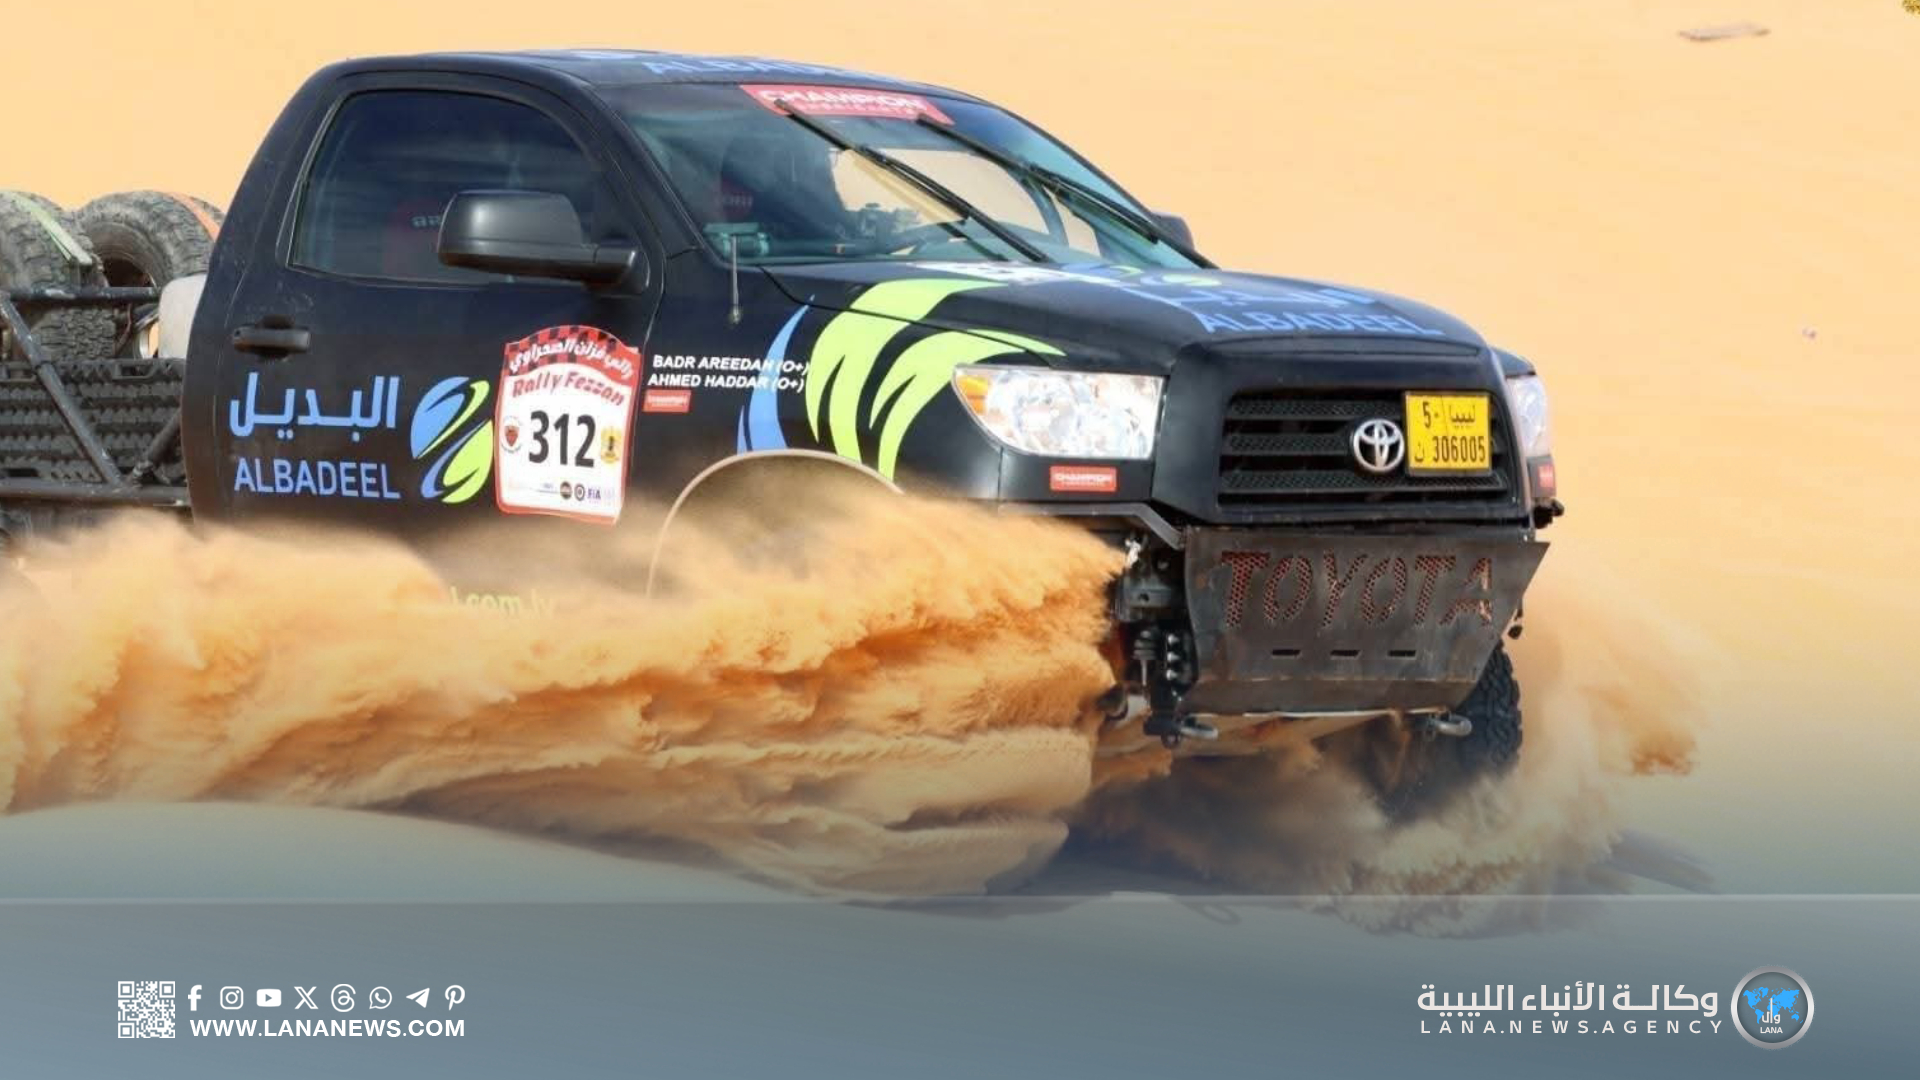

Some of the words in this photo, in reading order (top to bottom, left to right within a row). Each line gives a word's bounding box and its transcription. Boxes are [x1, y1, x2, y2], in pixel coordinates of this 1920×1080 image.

[1195, 311, 1445, 335] ALBADEEL
[652, 355, 696, 369] BADR
[697, 356, 776, 373] AREEDAH
[512, 371, 563, 398] Rally
[648, 373, 701, 388] AHMED
[703, 375, 770, 389] HADDAR
[229, 371, 400, 443] البديل
[528, 410, 597, 468] 312
[1432, 435, 1486, 463] 306005
[233, 456, 402, 499] ALBADEEL
[1220, 549, 1493, 628] TOYOTA
